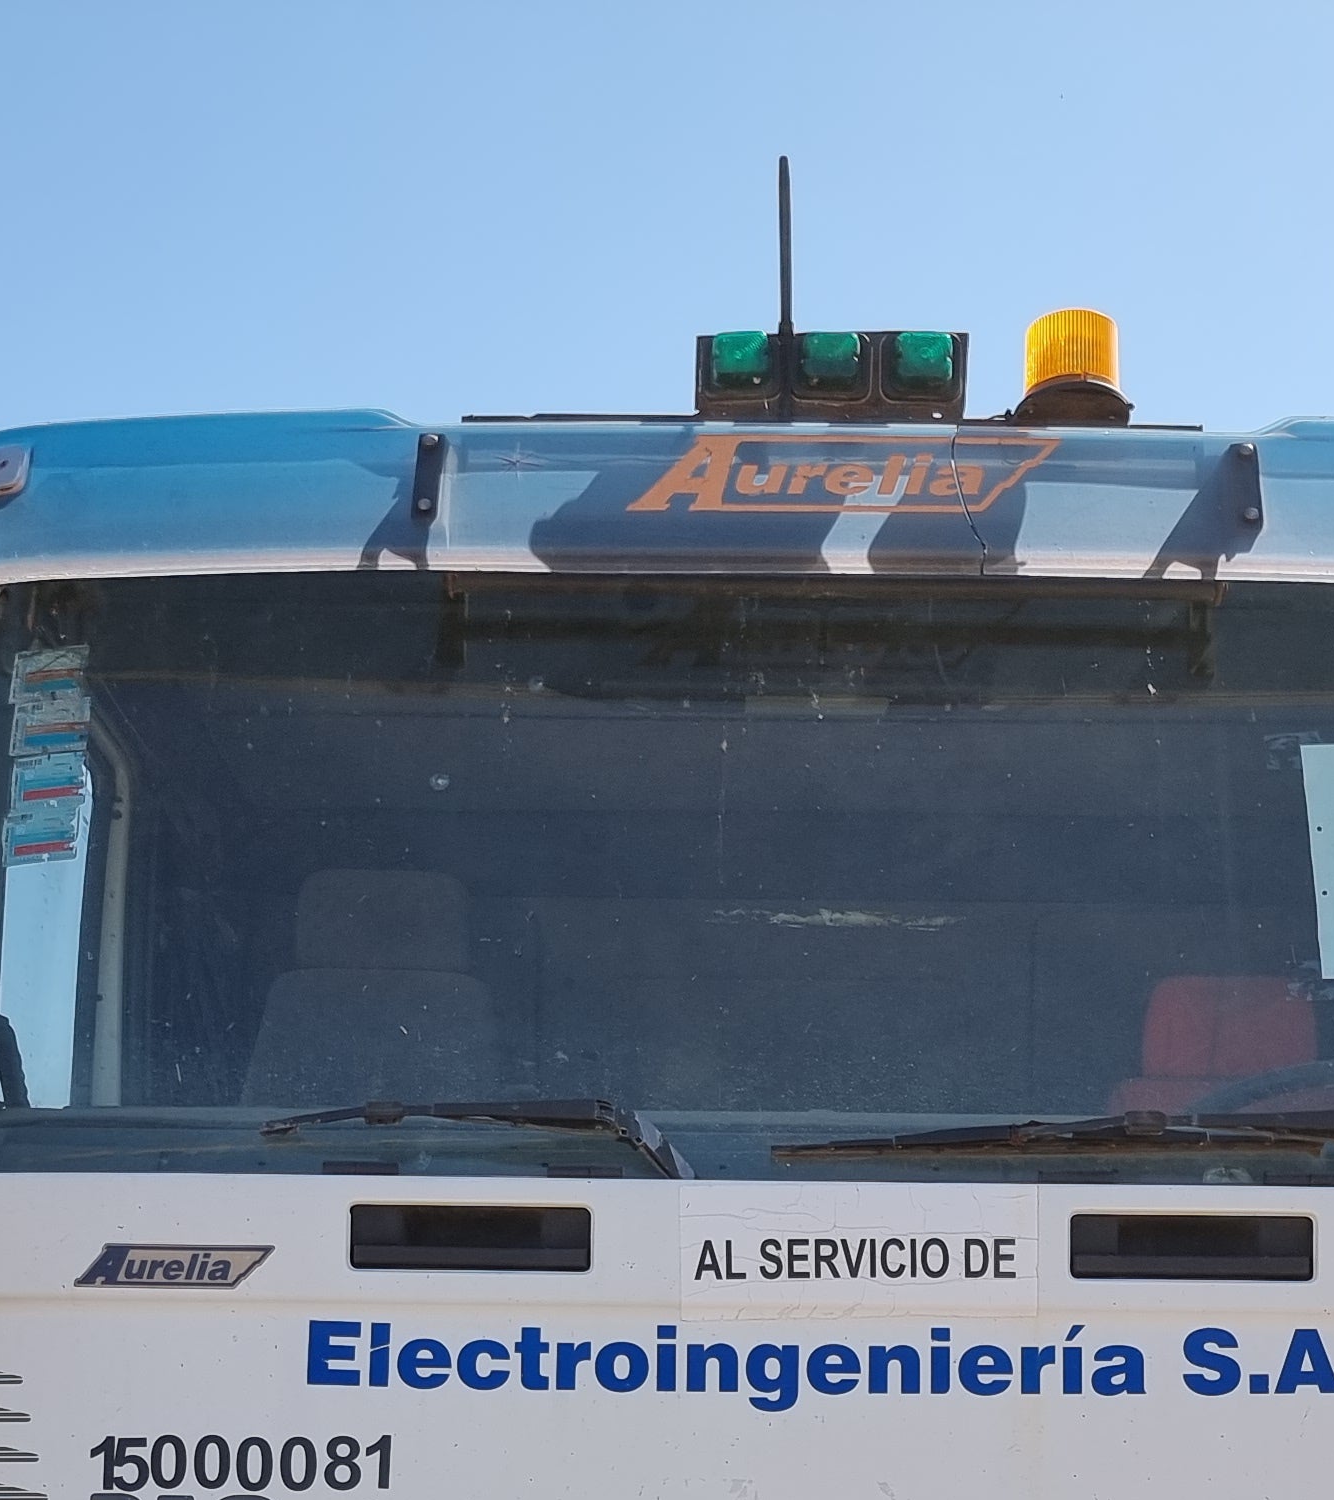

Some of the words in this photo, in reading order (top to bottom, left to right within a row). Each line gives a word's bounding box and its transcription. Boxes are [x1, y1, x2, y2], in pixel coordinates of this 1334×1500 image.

[627, 435, 985, 512] Aurelia
[77, 1244, 234, 1286] Aurelia
[694, 1240, 746, 1281] AL
[759, 1238, 953, 1281] SERVICIO
[963, 1238, 1017, 1279] DE
[306, 1319, 1145, 1412] Electroingeniería
[90, 1434, 393, 1491] 15000081
